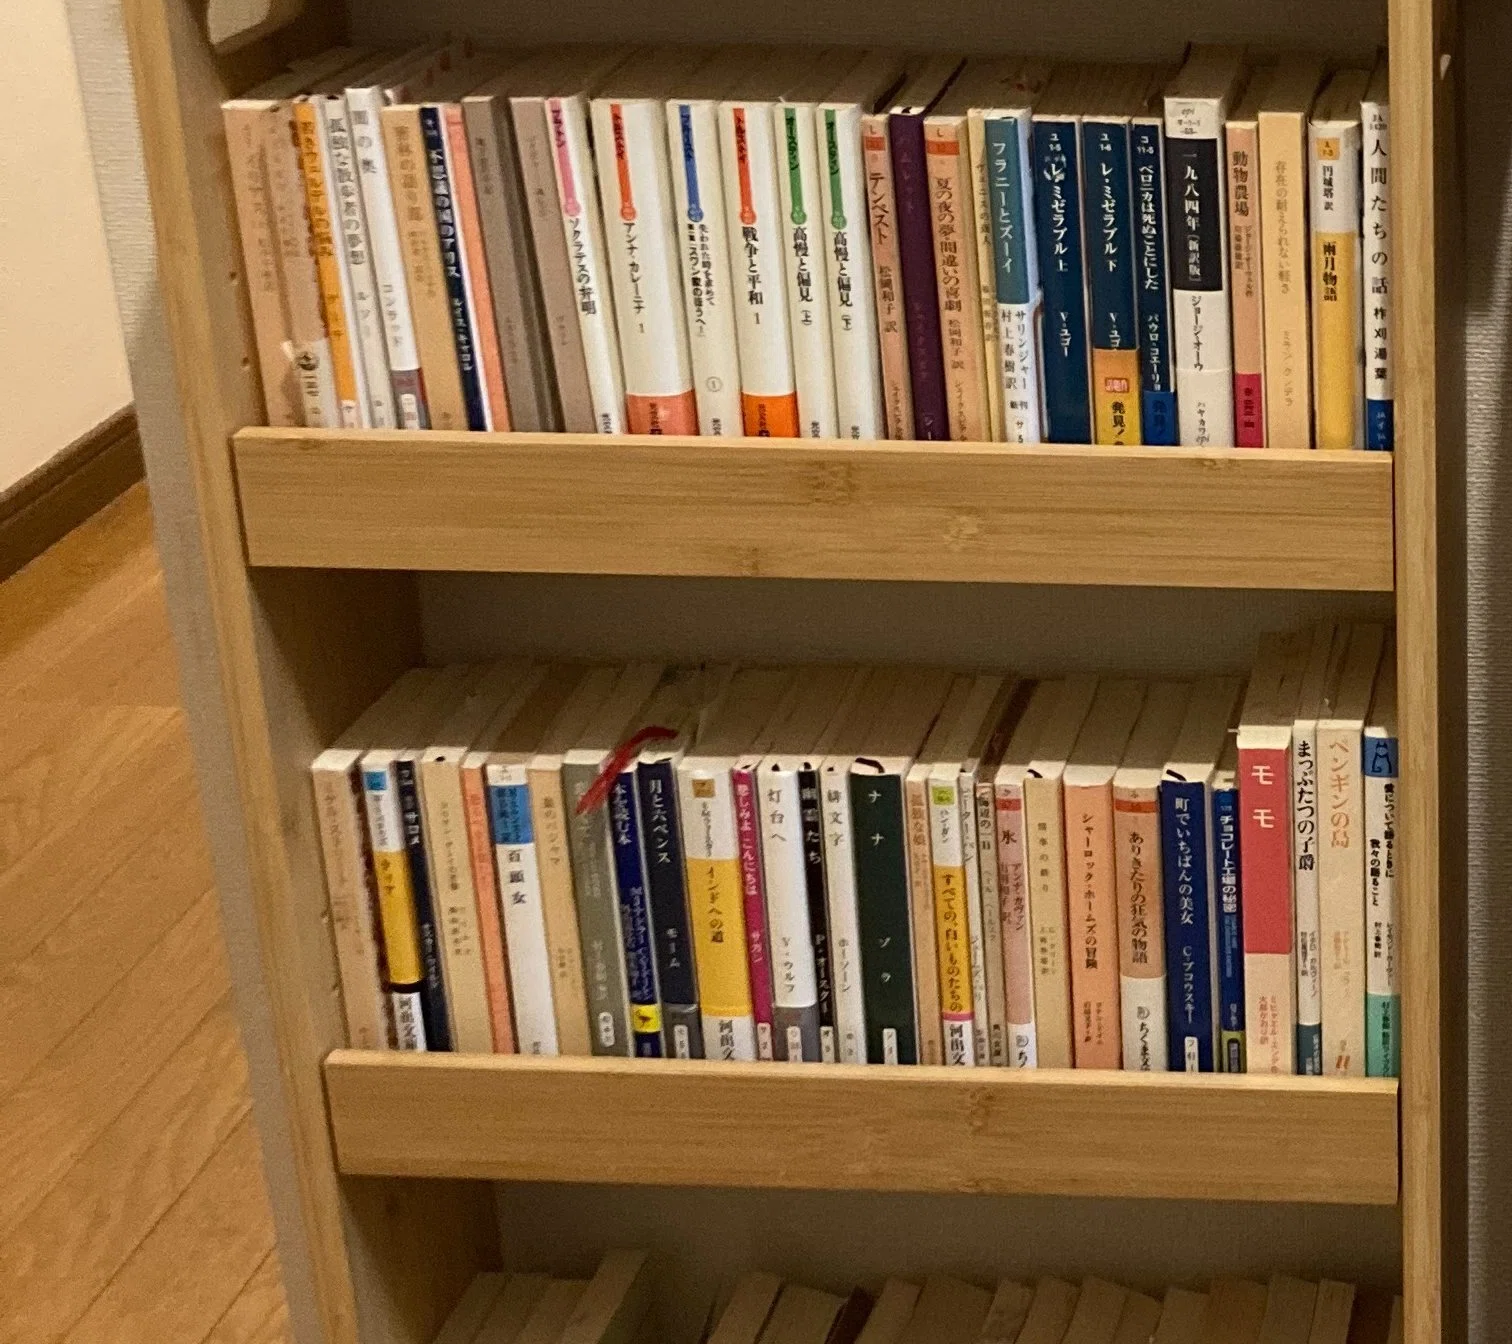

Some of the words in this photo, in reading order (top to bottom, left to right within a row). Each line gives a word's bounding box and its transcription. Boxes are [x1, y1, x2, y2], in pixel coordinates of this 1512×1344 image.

[869, 171, 890, 246] テンペスト
[992, 142, 1013, 274] フラニーとズーイ
[1098, 162, 1119, 256] レ・ミゼラブル
[1137, 164, 1158, 293] ベロニカは死ぬことにした
[1230, 149, 1251, 219] 動物農場
[1369, 138, 1390, 296] 人間たちの話
[567, 217, 599, 315] ソクラテスの弁明
[623, 223, 645, 315] アンナ・カレーニナ
[741, 226, 765, 306] 戦争と平和
[791, 228, 815, 304] 高慢と偏見
[832, 231, 855, 309] 高慢と偏見
[1014, 308, 1033, 391] サリンジャー
[648, 778, 673, 864] 月と六ペンス
[767, 788, 788, 843] 灯台へ
[1250, 764, 1275, 830] モモ
[1295, 740, 1316, 873] まっぷたつの子爵
[1327, 737, 1352, 851] ペンギンの島
[705, 865, 726, 944] インドへの道
[1078, 811, 1101, 971] シャーロック・ホームズの冒険
[1127, 831, 1149, 966] ありきたりの狂気の物語
[1173, 794, 1195, 926] 町でいちばんの美女
[1218, 814, 1237, 915] チョコレート工場の秘密
[940, 873, 963, 1013] すべての、白いものたちの
